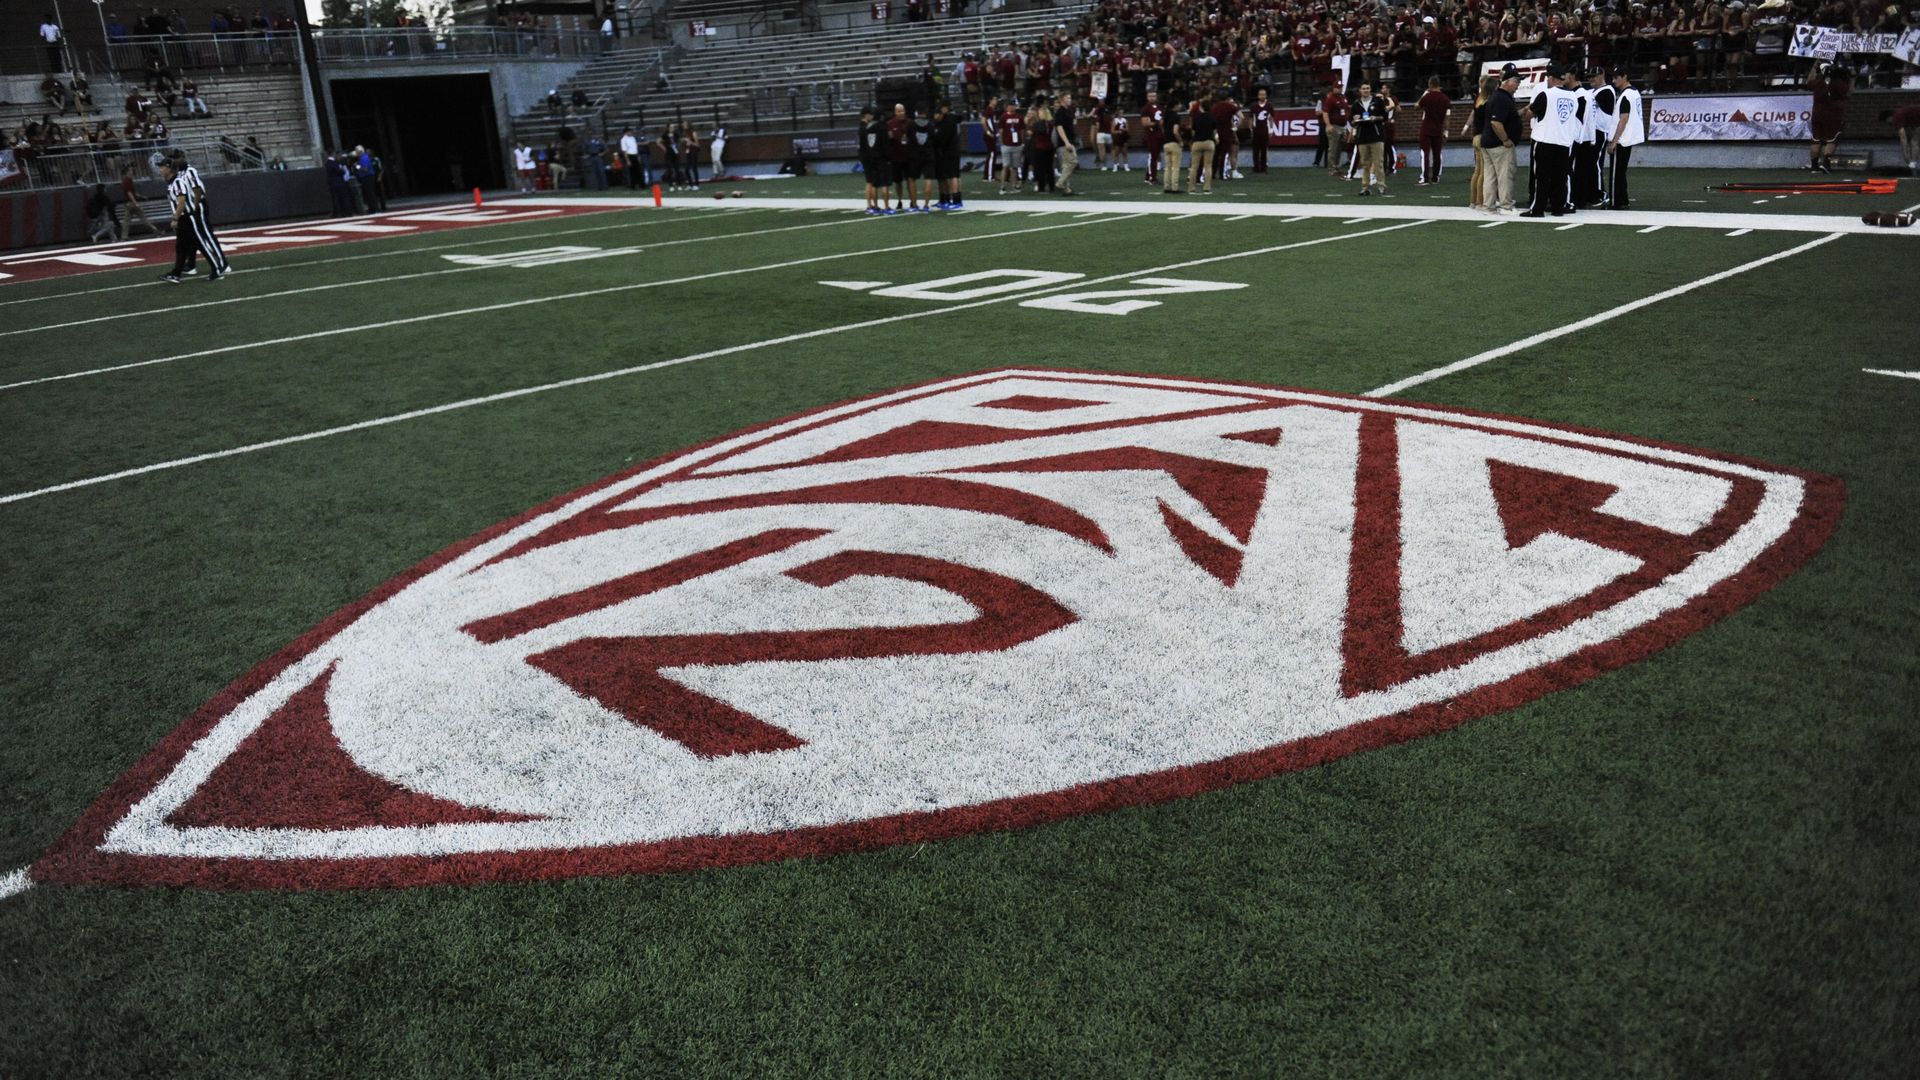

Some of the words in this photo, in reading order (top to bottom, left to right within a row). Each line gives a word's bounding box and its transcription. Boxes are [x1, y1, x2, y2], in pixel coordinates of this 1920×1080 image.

[1841, 42, 1860, 52] PASS
[1654, 108, 1692, 124] Coors
[1693, 112, 1728, 123] LIGHT
[1752, 111, 1796, 122] CLIMB
[1800, 111, 1812, 122] O
[1270, 119, 1320, 137] NISS
[460, 528, 1080, 757] 12
